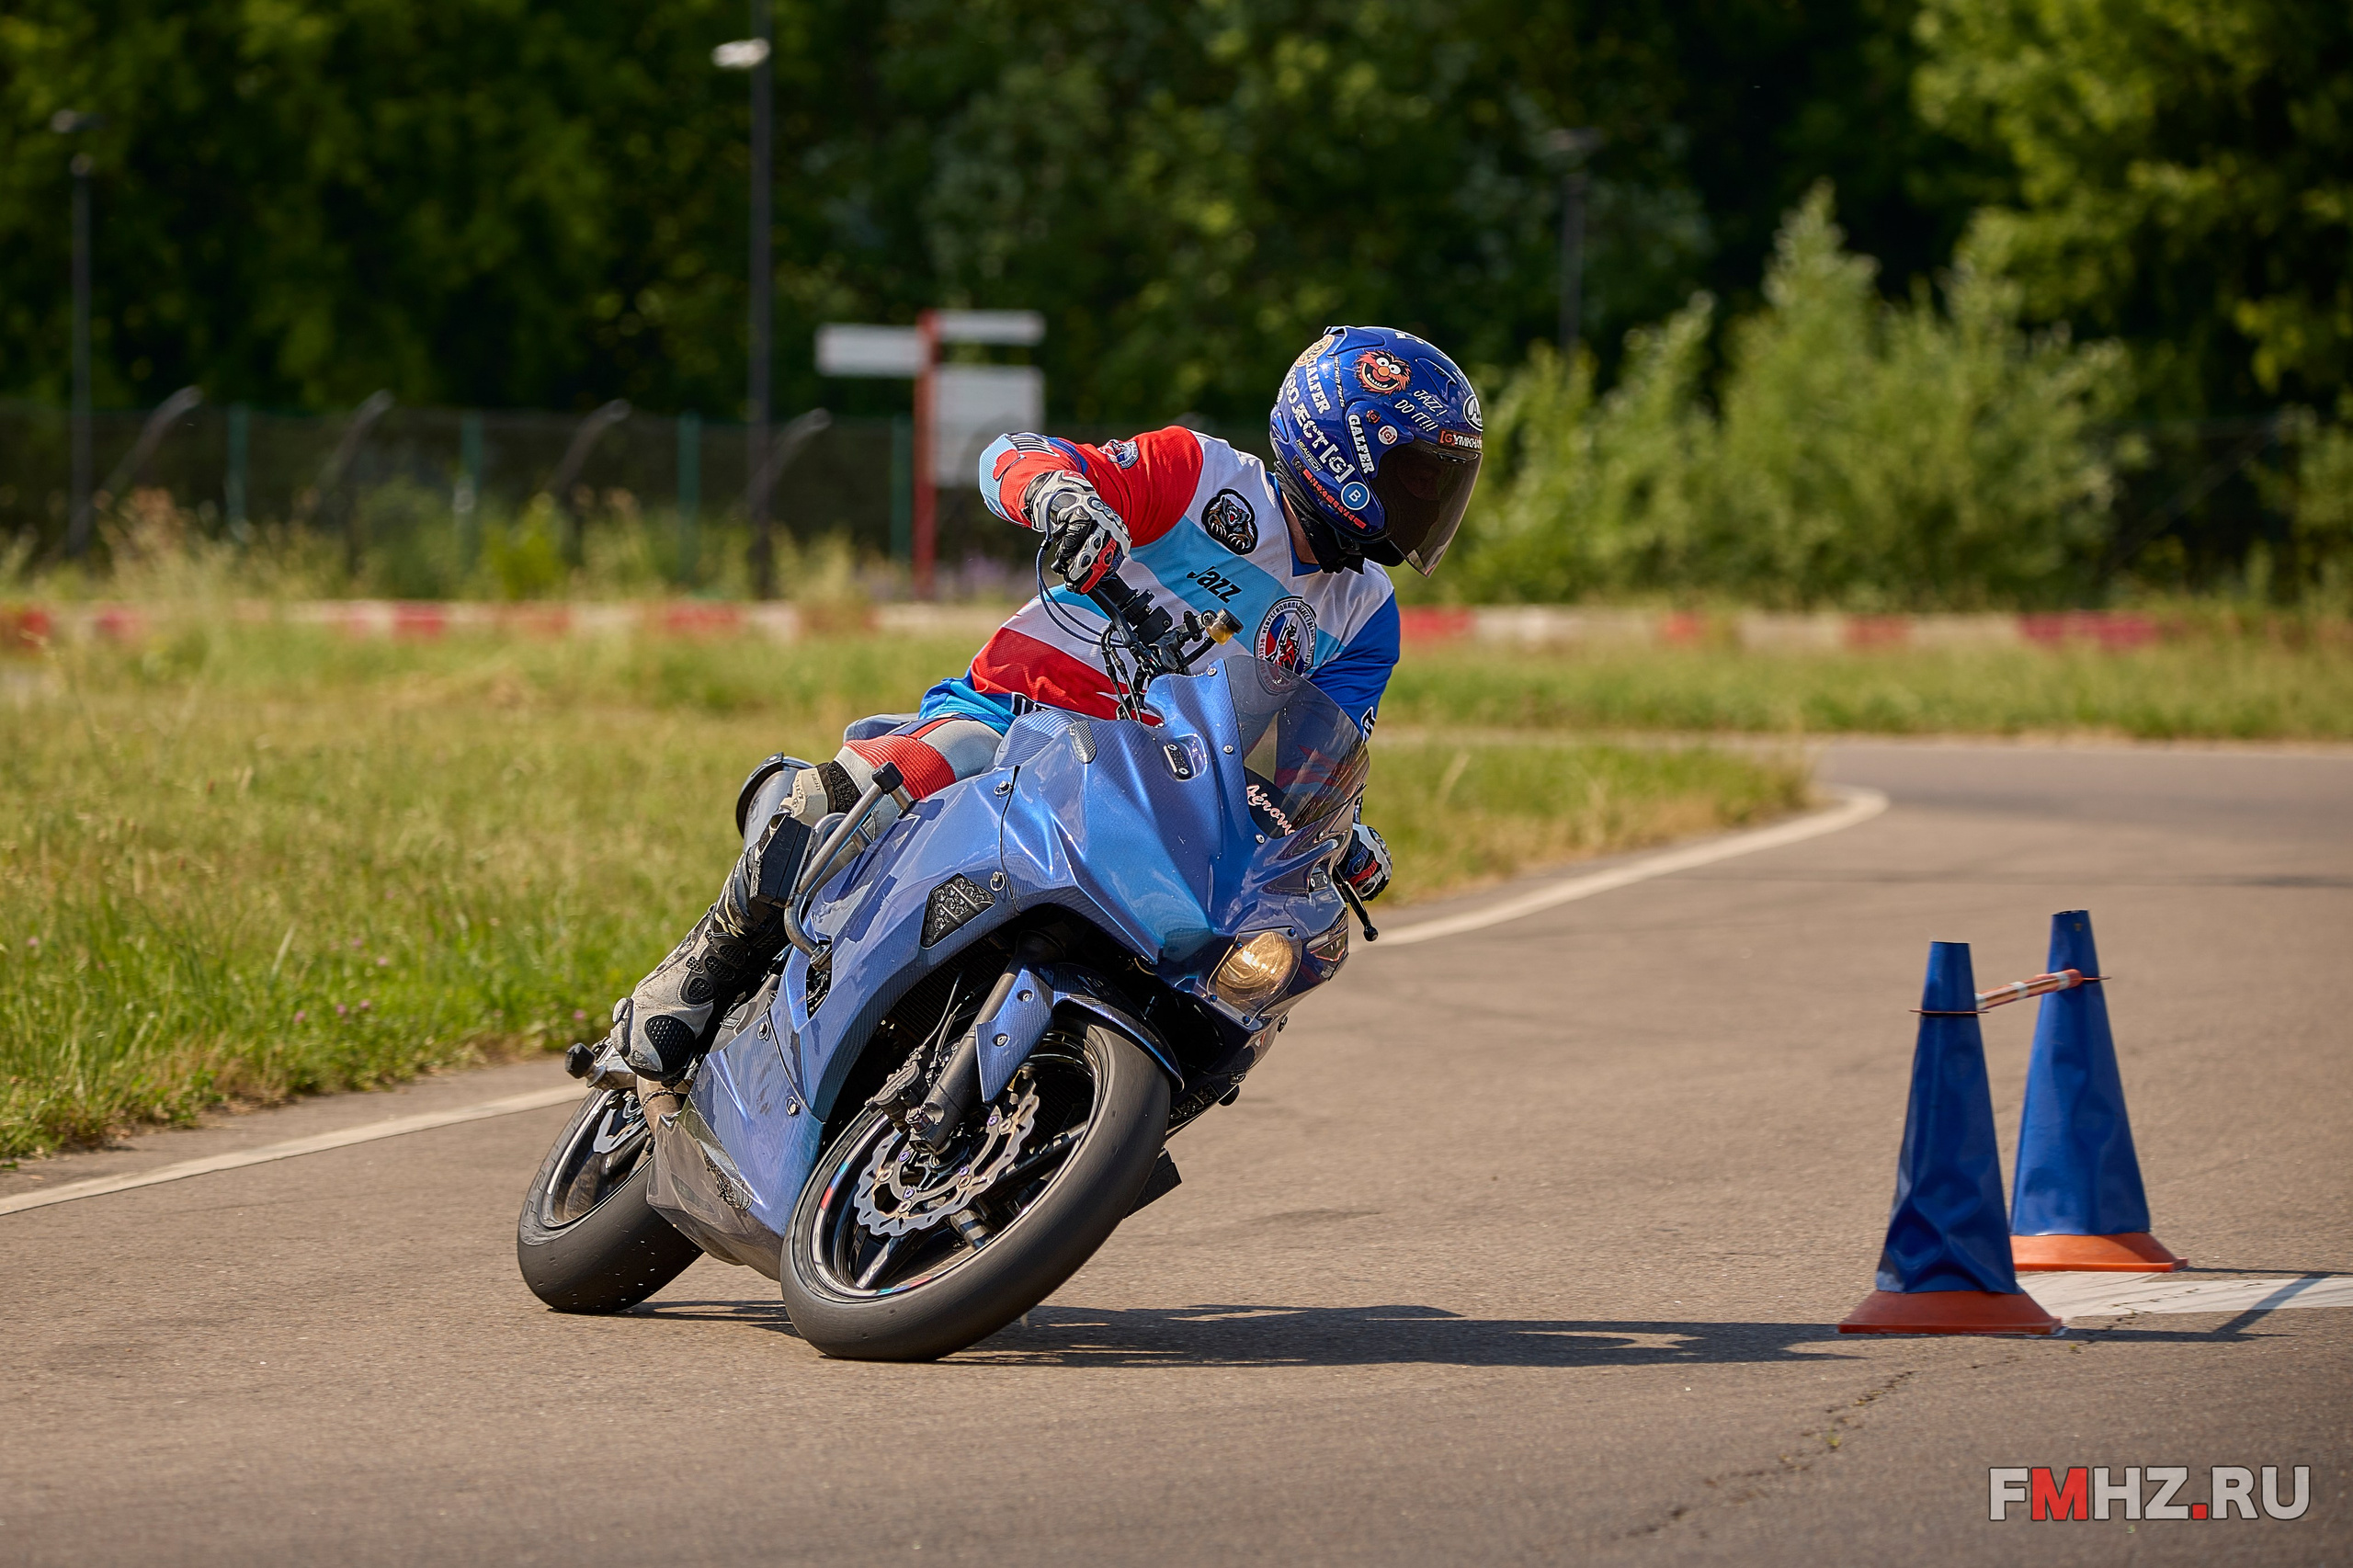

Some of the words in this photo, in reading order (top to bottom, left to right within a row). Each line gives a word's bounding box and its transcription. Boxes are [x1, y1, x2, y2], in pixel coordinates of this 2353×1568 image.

[1394, 399, 1415, 414] DO
[1411, 411, 1439, 433] IT!!!
[1413, 389, 1448, 417] JAZZ!
[1296, 439, 1323, 472] HEALTECH
[1347, 414, 1375, 474] GALFER
[1347, 488, 1361, 503] B
[1186, 565, 1243, 604] Jazz
